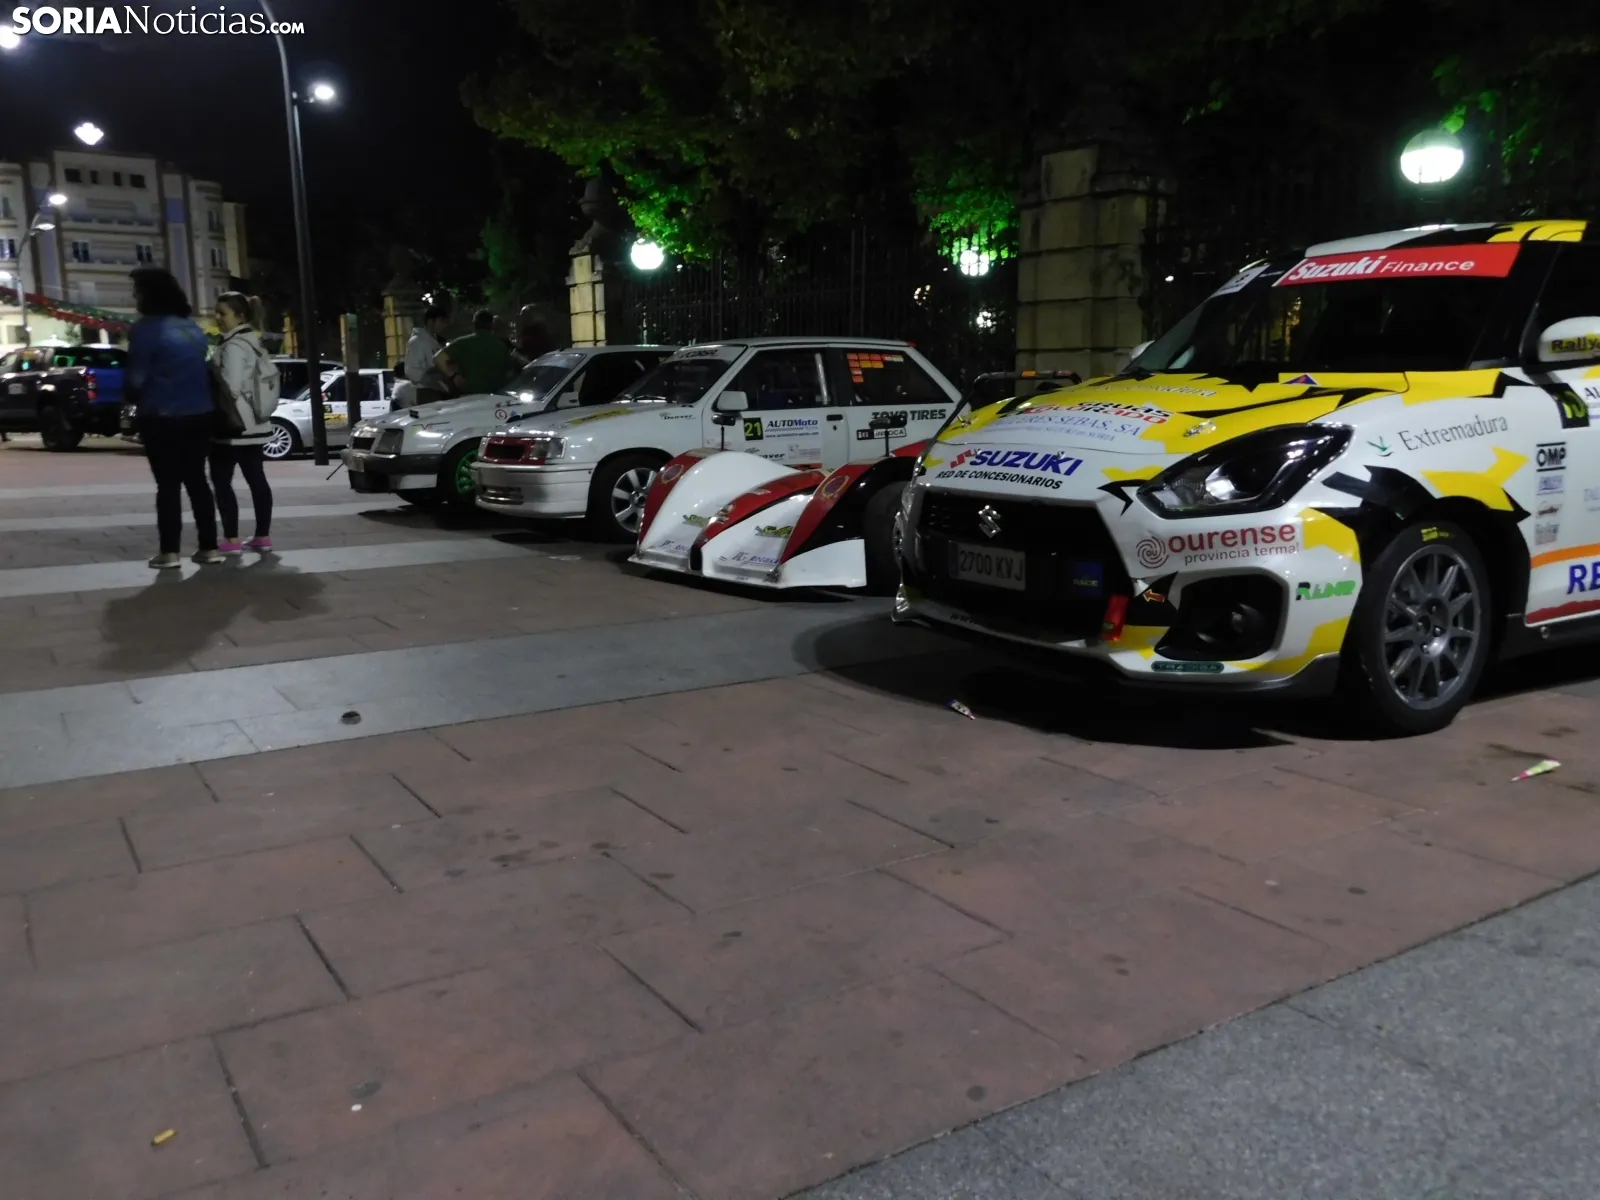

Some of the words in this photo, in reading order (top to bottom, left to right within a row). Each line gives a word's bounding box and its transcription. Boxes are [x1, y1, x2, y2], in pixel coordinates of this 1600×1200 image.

[1288, 254, 1388, 281] Suzuki
[1379, 260, 1475, 273] Finance
[909, 409, 947, 420] TIRES
[1077, 402, 1173, 418] GRUAS
[744, 422, 762, 437] 21
[766, 418, 818, 428] AUTOMoto
[1114, 422, 1140, 437] SA
[1397, 414, 1509, 451] Extremadura
[970, 450, 1083, 476] SUZUKI
[1536, 446, 1566, 467] OMP
[935, 470, 955, 480] RED
[954, 470, 967, 479] DE
[969, 471, 1063, 490] CONCESIONARIOS
[1168, 524, 1296, 553] ourense
[959, 550, 993, 576] 2700
[1184, 550, 1250, 566] provincia
[1254, 542, 1300, 557] termal
